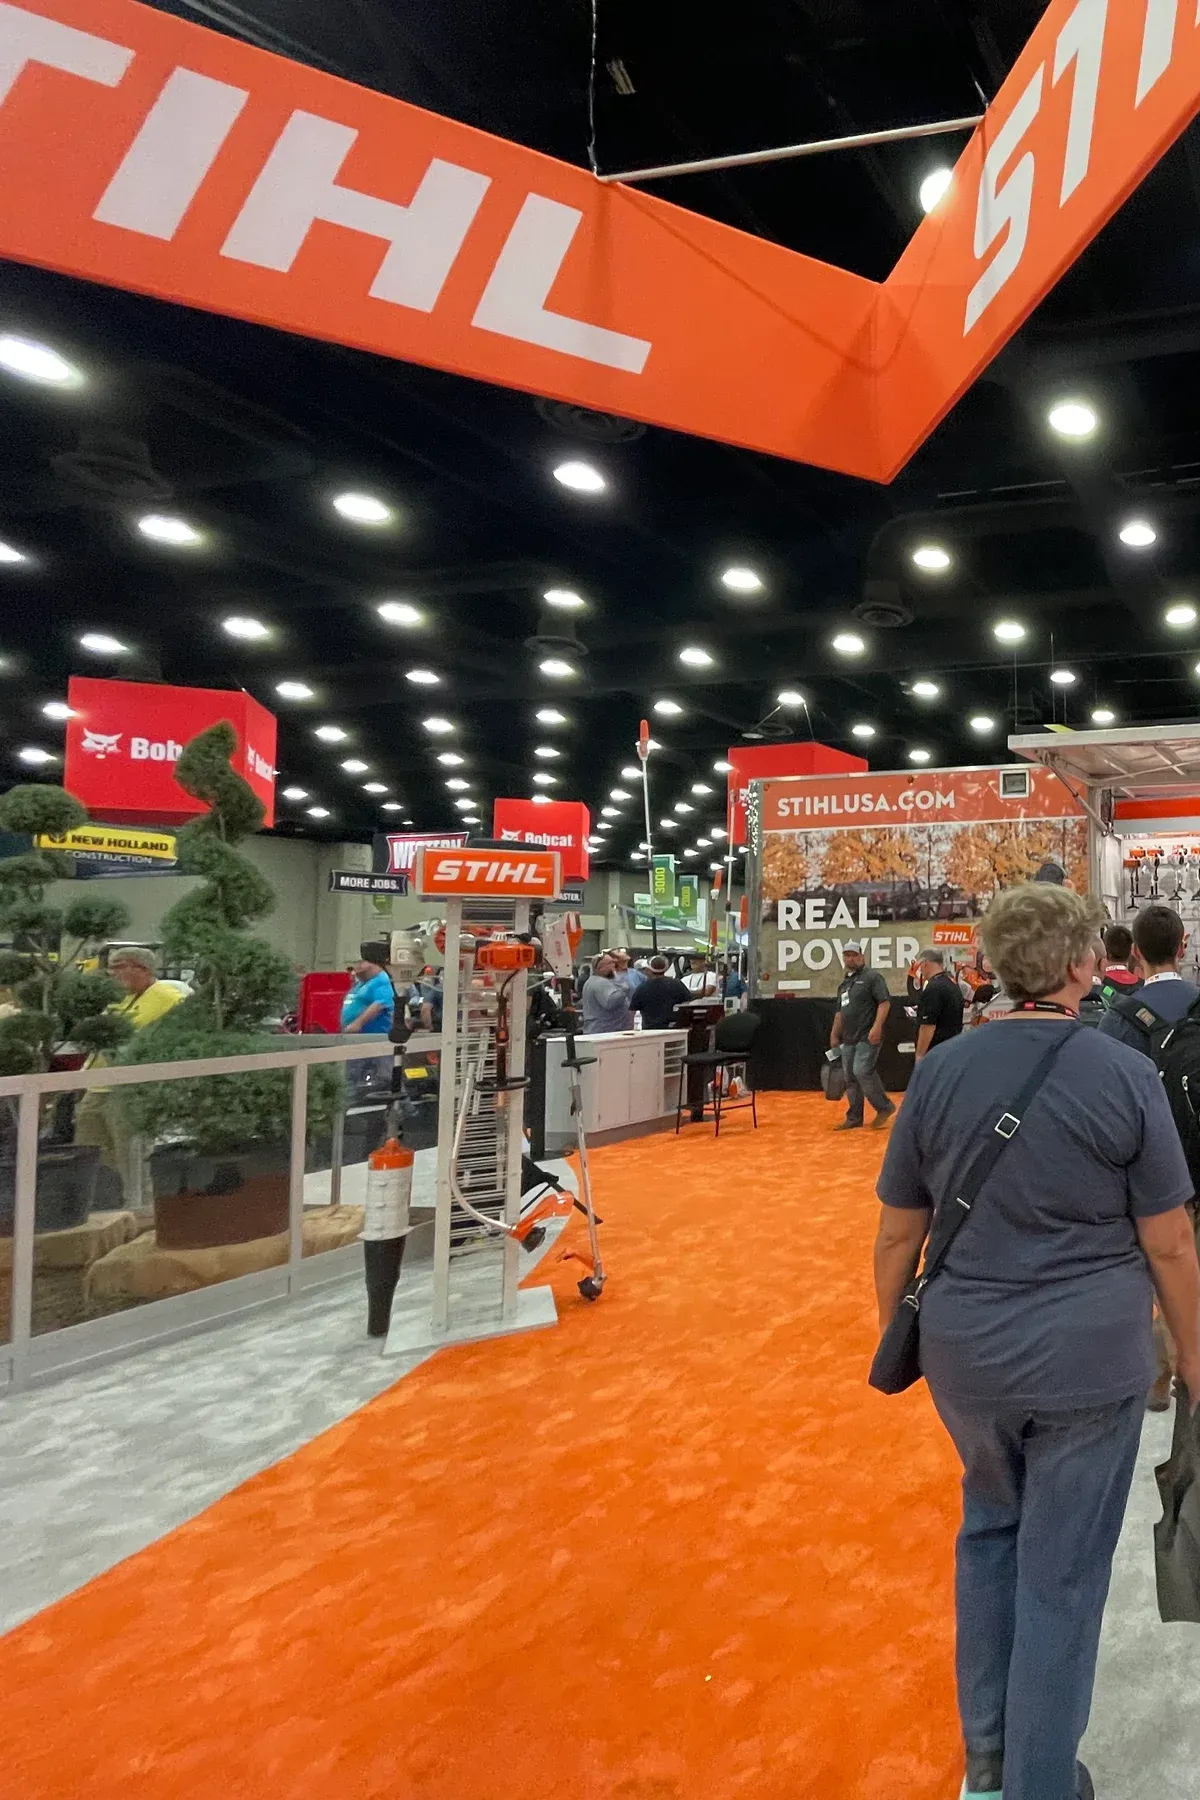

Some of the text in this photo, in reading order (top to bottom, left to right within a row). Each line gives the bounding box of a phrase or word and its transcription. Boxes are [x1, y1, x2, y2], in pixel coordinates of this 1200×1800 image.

[777, 790, 956, 818] STIHLUSA.COM
[71, 834, 169, 851] NEW HOLLAND
[340, 876, 400, 890] MORE JOBS.
[432, 859, 547, 884] STIHL
[655, 867, 666, 894] 3000
[777, 896, 880, 931] REAL
[933, 930, 971, 943] STIHL
